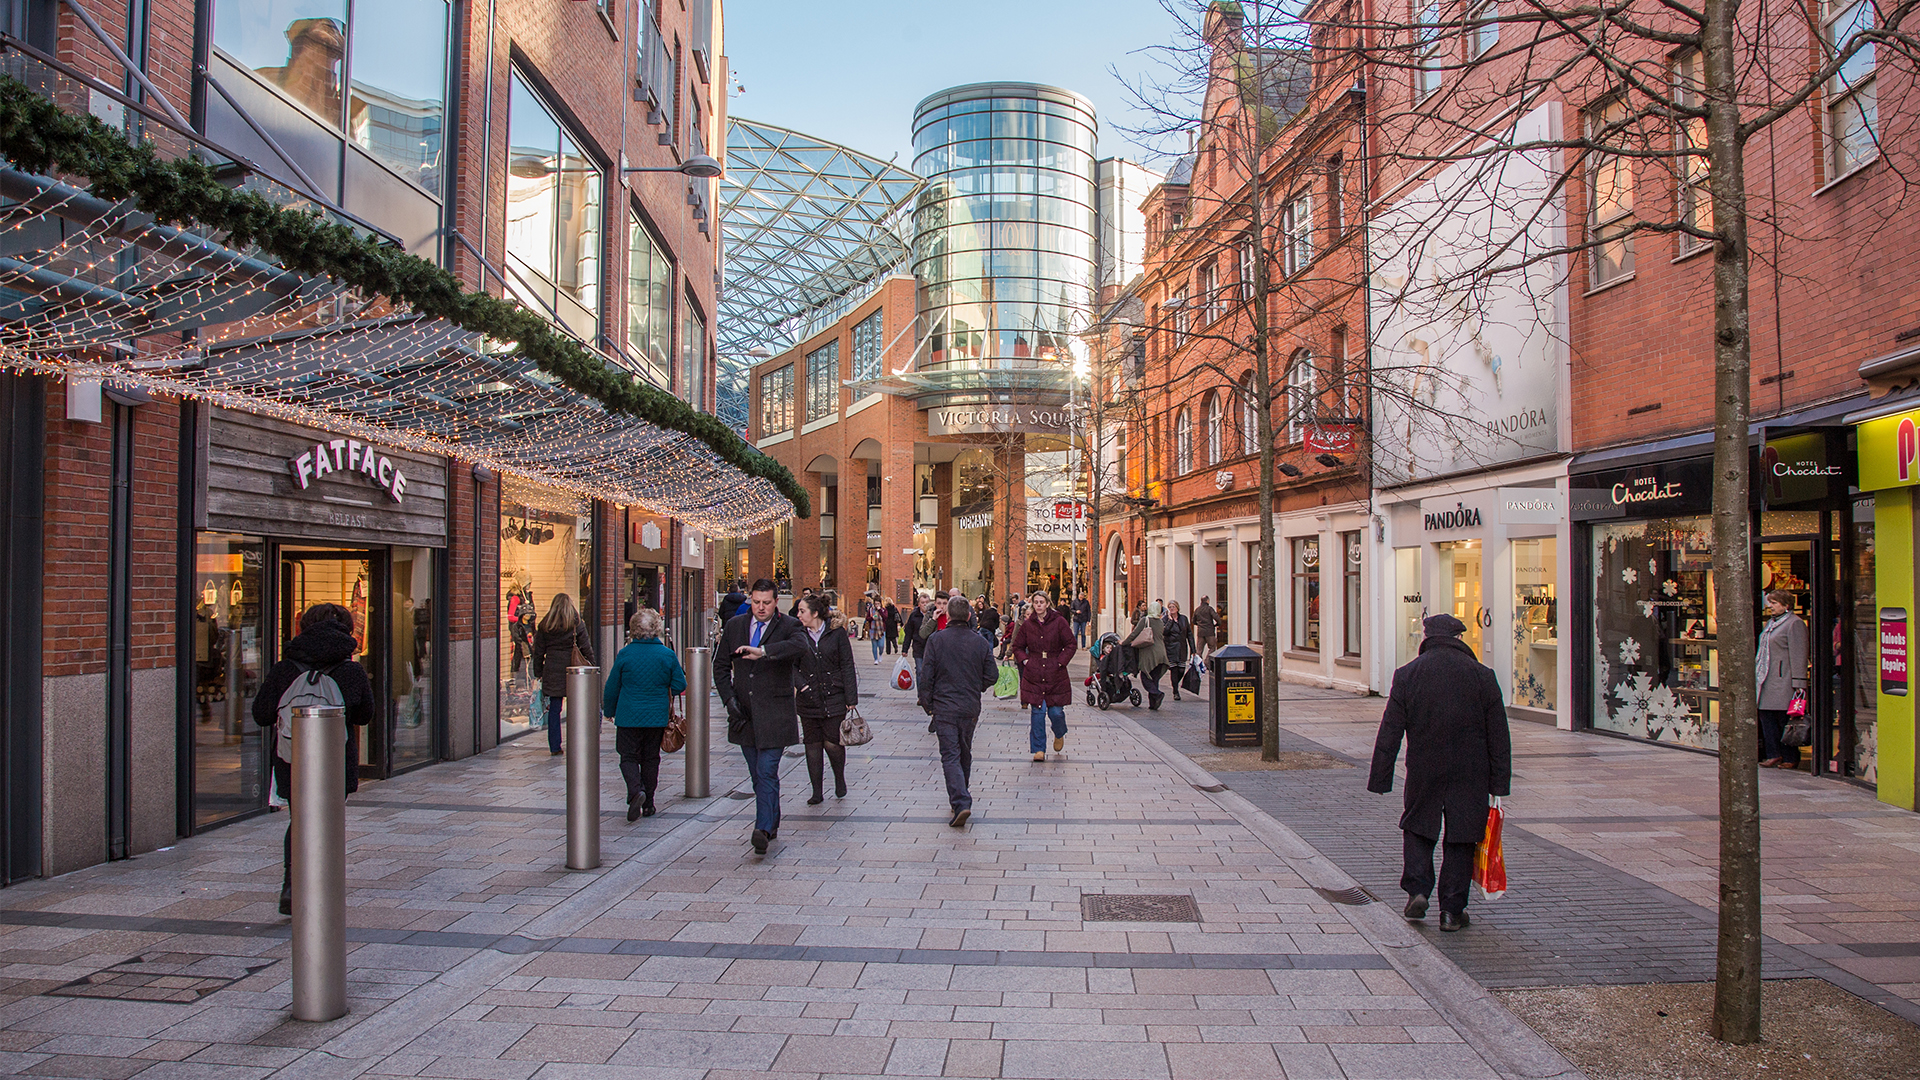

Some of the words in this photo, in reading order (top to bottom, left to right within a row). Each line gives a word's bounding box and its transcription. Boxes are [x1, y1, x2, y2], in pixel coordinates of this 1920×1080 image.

[937, 410, 1022, 426] VICTORIA
[295, 439, 407, 503] FATFACE
[1634, 477, 1657, 486] HOTEL
[329, 512, 366, 528] BELFAST
[1881, 632, 1906, 646] Unlocks
[1881, 657, 1906, 674] Repairs
